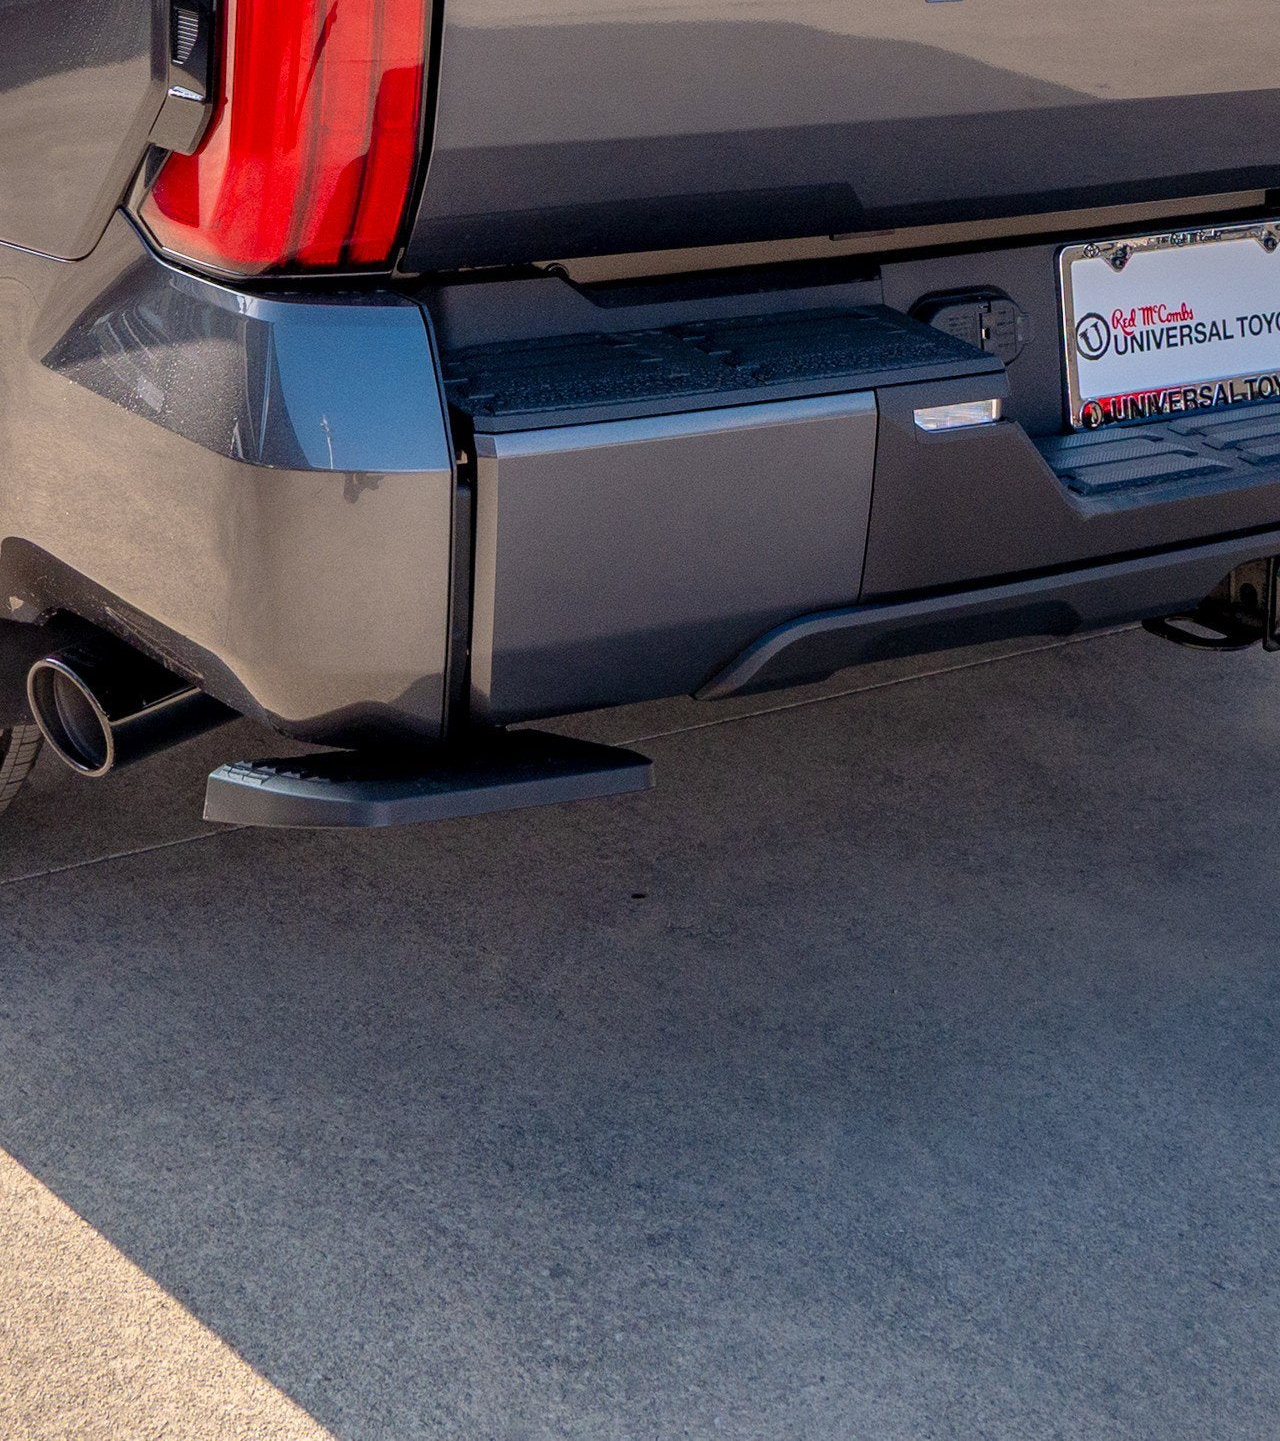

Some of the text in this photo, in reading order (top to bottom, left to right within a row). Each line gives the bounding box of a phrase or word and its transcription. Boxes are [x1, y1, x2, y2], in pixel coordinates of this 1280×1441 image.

[1111, 302, 1194, 337] Red McCombs
[1113, 319, 1234, 356] UNIVERSAL
[1110, 383, 1242, 419] UNIVERSAL
